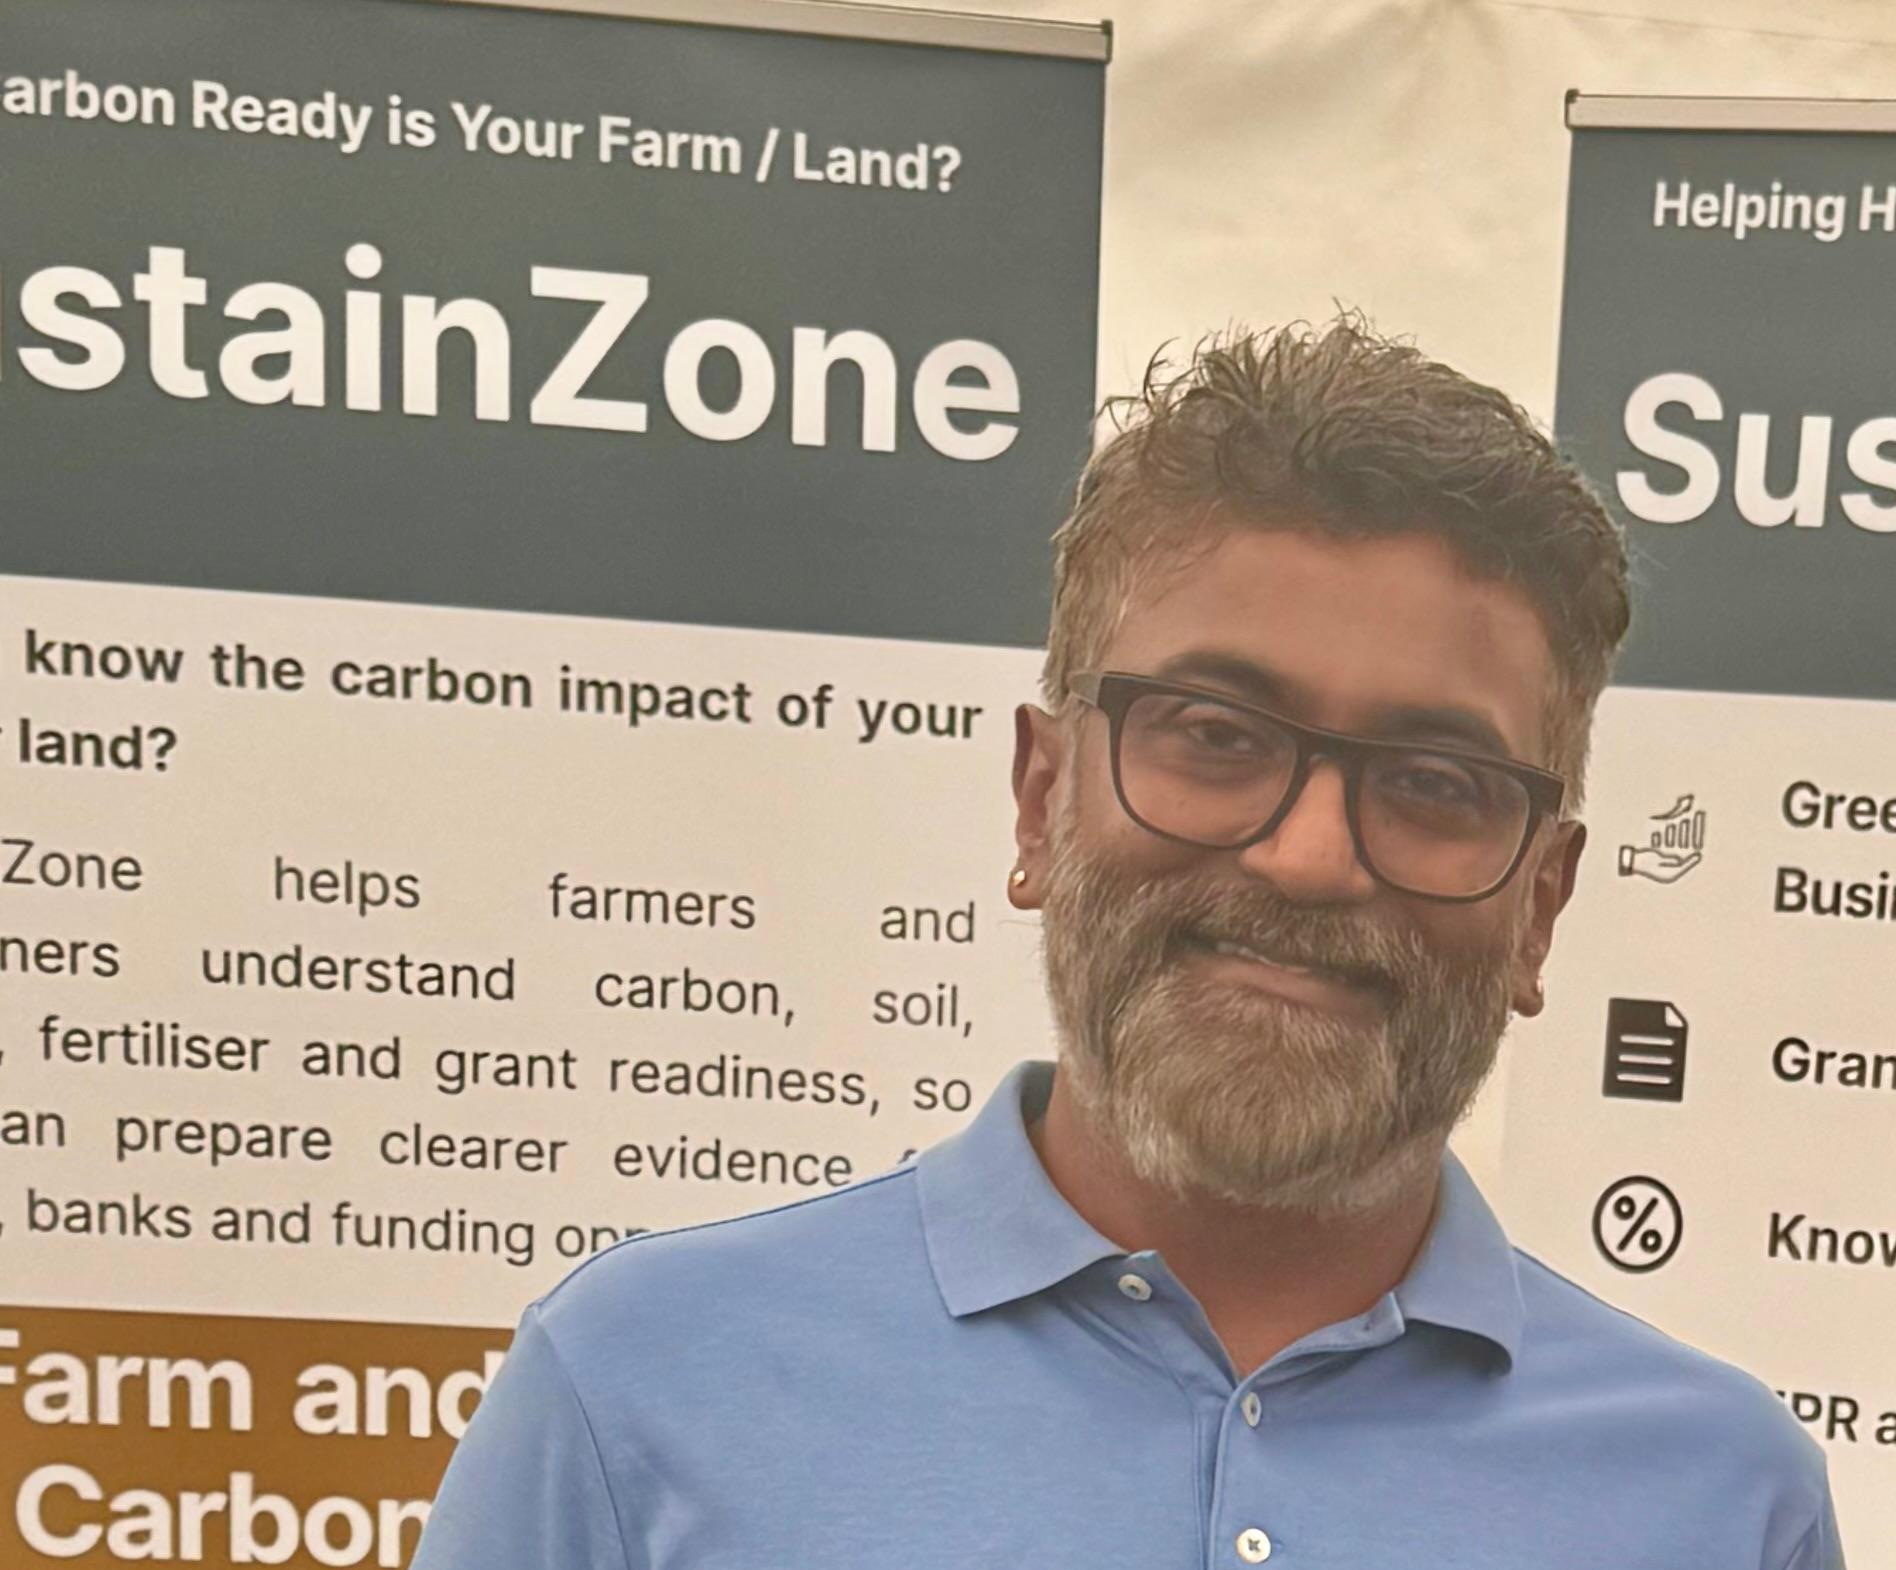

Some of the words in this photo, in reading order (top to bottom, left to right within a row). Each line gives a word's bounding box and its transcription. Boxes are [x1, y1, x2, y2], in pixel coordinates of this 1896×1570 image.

[193, 81, 372, 153] Ready
[389, 95, 435, 146] is
[452, 103, 584, 159] Your
[600, 116, 741, 173] Farm
[757, 128, 779, 182] /
[795, 132, 960, 192] Land?
[1654, 182, 1845, 241] Helping
[19, 244, 1019, 460] stainZone
[26, 629, 183, 682] know
[210, 644, 304, 690] the
[332, 658, 531, 707] carbon
[561, 665, 751, 727] impact
[778, 684, 833, 728] of
[858, 699, 983, 743] your
[20, 718, 176, 771] land?
[1, 839, 142, 891] Zone
[276, 856, 420, 917] helps
[549, 873, 755, 929] farmers
[881, 901, 974, 943] and
[203, 945, 514, 1000] understand
[596, 968, 793, 1027] carbon,
[873, 983, 971, 1037] soil,
[39, 1015, 270, 1071] fertiliser
[303, 1037, 400, 1079] and
[436, 1050, 576, 1094] grant
[611, 1055, 878, 1116] readiness,
[914, 1078, 971, 1111] so
[117, 1117, 331, 1166] prepare
[381, 1123, 568, 1172] clearer
[614, 1135, 852, 1187] evidence
[28, 1188, 191, 1238] banks
[212, 1202, 310, 1243] and
[332, 1201, 533, 1266] funding
[1776, 1391, 1859, 1442] PR
[14, 1463, 436, 1568] Carbon
